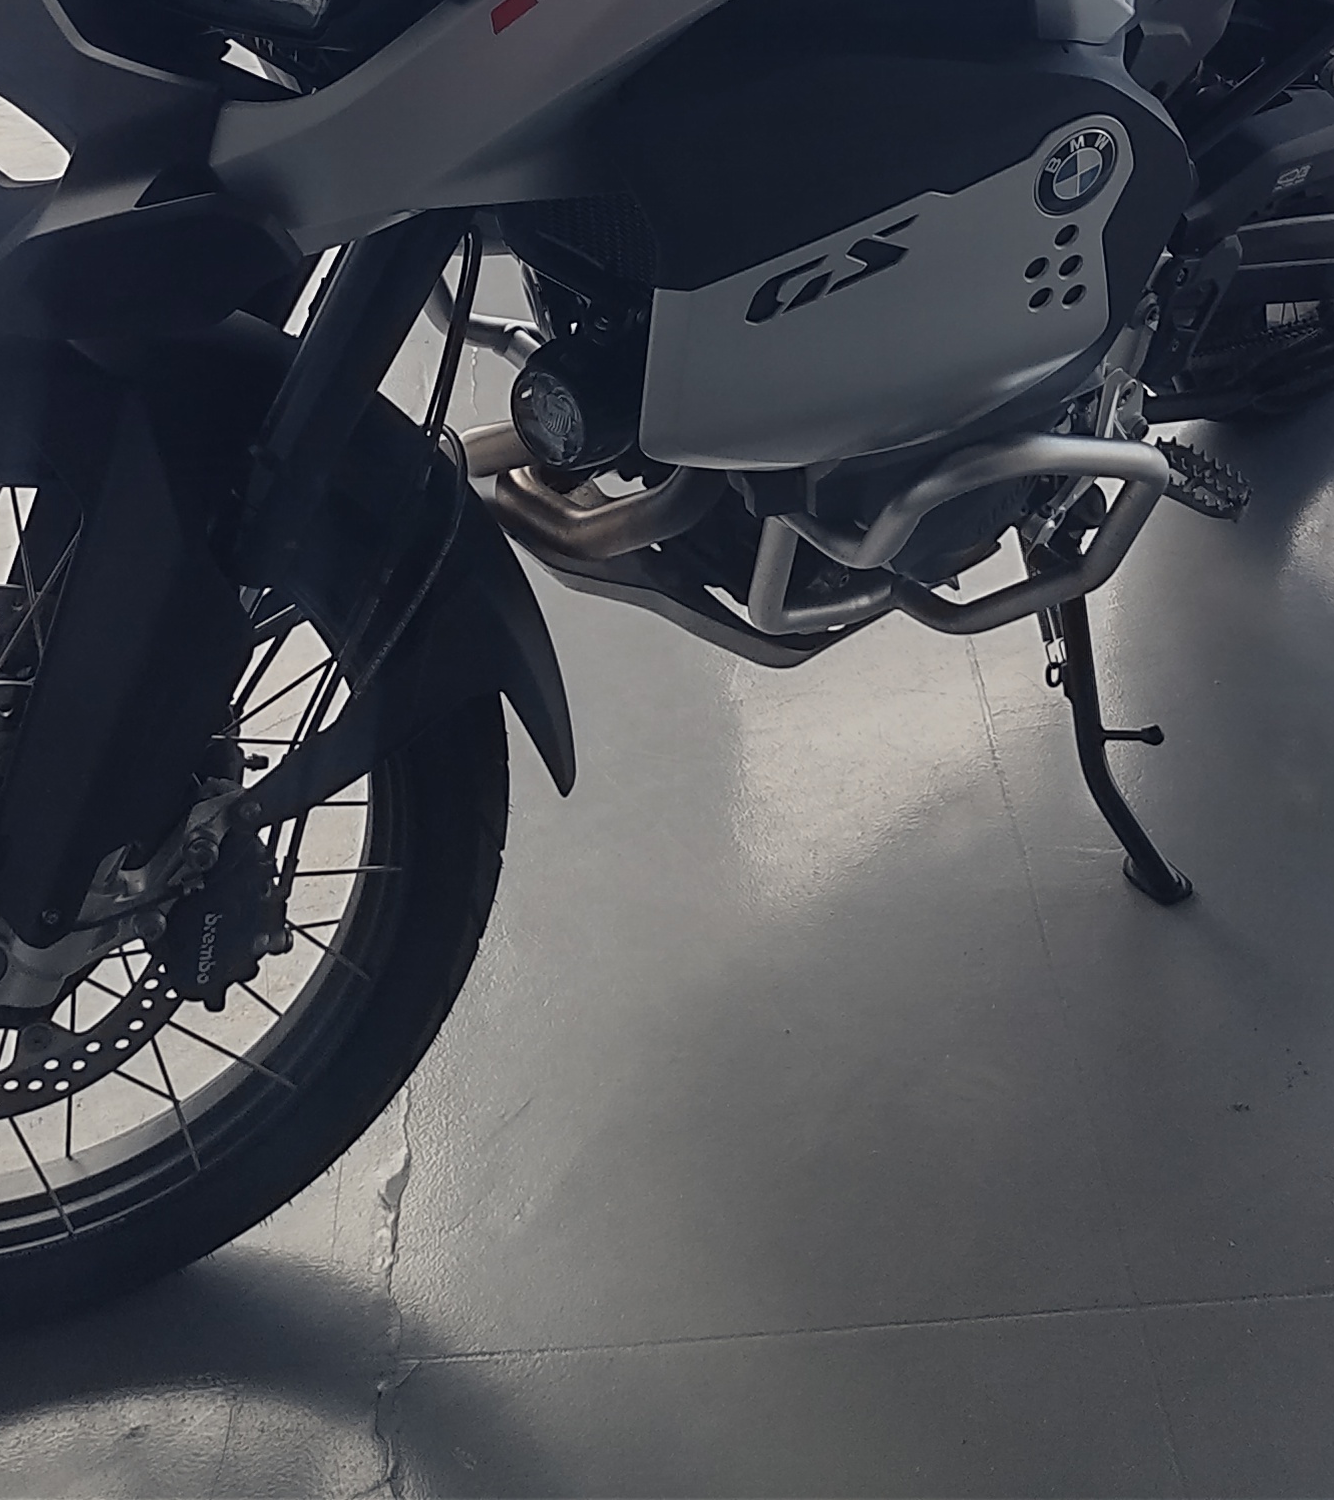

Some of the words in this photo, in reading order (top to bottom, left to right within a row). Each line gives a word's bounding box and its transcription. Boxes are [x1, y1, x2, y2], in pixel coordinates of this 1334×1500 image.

[1045, 133, 1109, 174] BMW
[745, 214, 920, 325] GS
[196, 913, 223, 984] brembo
